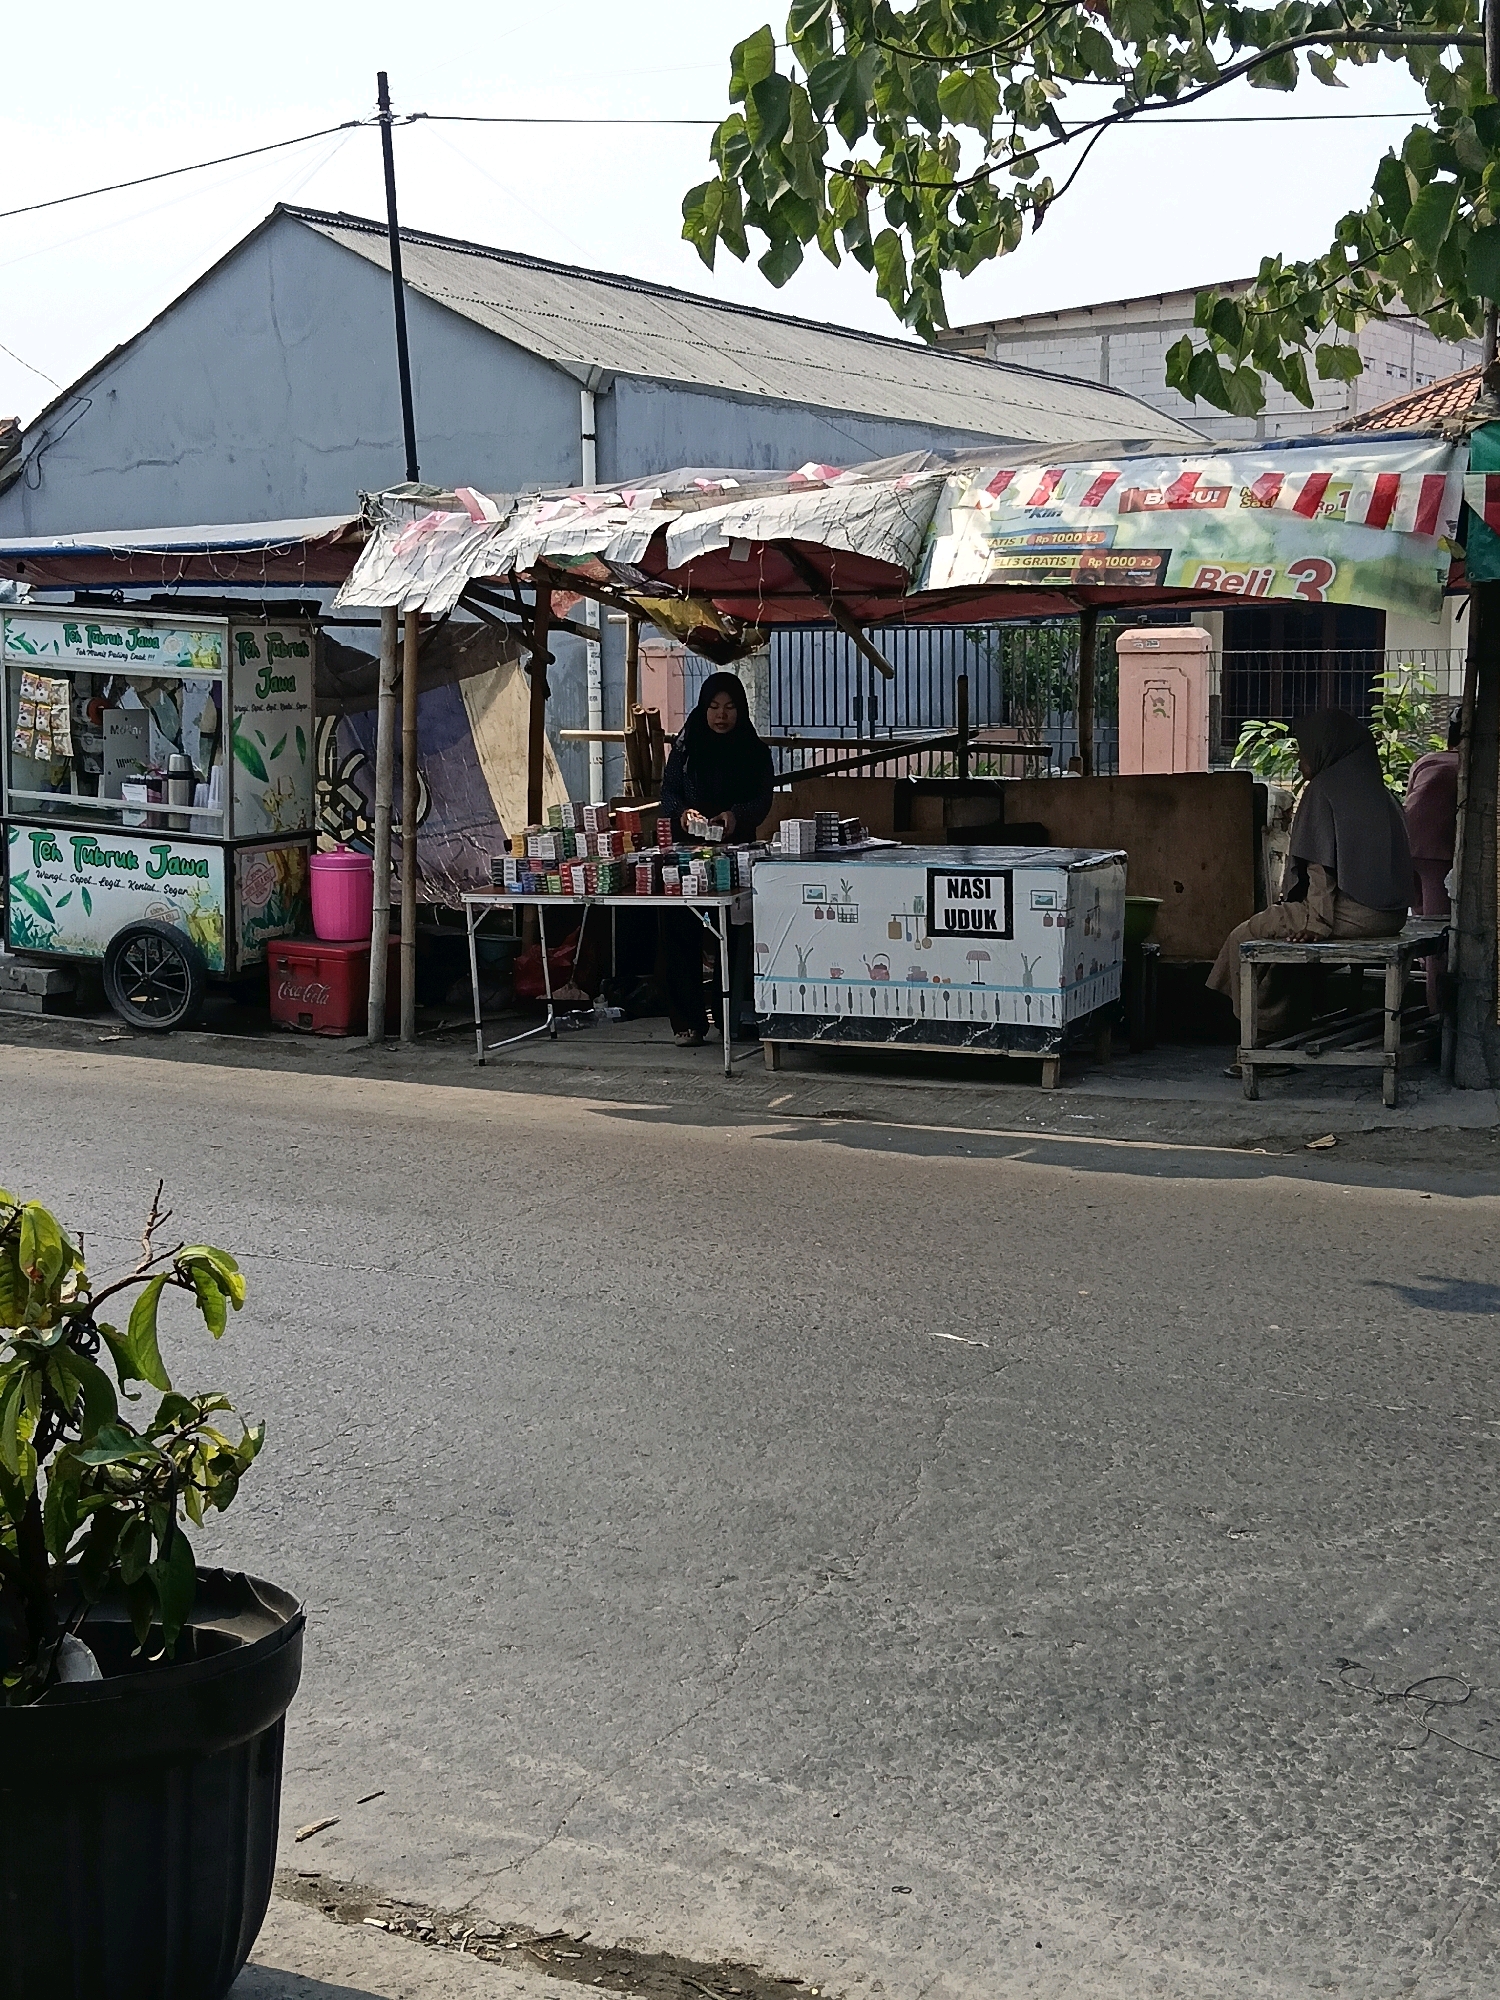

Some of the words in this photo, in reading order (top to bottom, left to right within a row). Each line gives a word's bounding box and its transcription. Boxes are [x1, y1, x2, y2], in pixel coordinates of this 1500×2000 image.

[1035, 535, 1050, 545] Rp
[1052, 533, 1083, 544] 1000
[1086, 534, 1098, 542] x2
[1012, 557, 1020, 566] 3
[1022, 556, 1068, 566] GRATIS
[1071, 557, 1077, 565] 1
[1088, 557, 1102, 568] Rp
[1104, 556, 1137, 567] 1000
[1140, 558, 1153, 566] x2
[1194, 567, 1273, 597] Beli
[1286, 557, 1334, 602] 3
[63, 623, 83, 648] Teh
[85, 625, 123, 649] Tubruk
[125, 627, 160, 652] Jawa
[235, 631, 261, 666] Teh
[264, 632, 310, 665] Tubruk
[255, 666, 297, 699] Jawa
[28, 831, 63, 868] Teh
[69, 836, 140, 873] Tubruk
[145, 844, 210, 880] Jawa
[946, 877, 992, 900] NASI
[944, 908, 998, 931] UDUK
